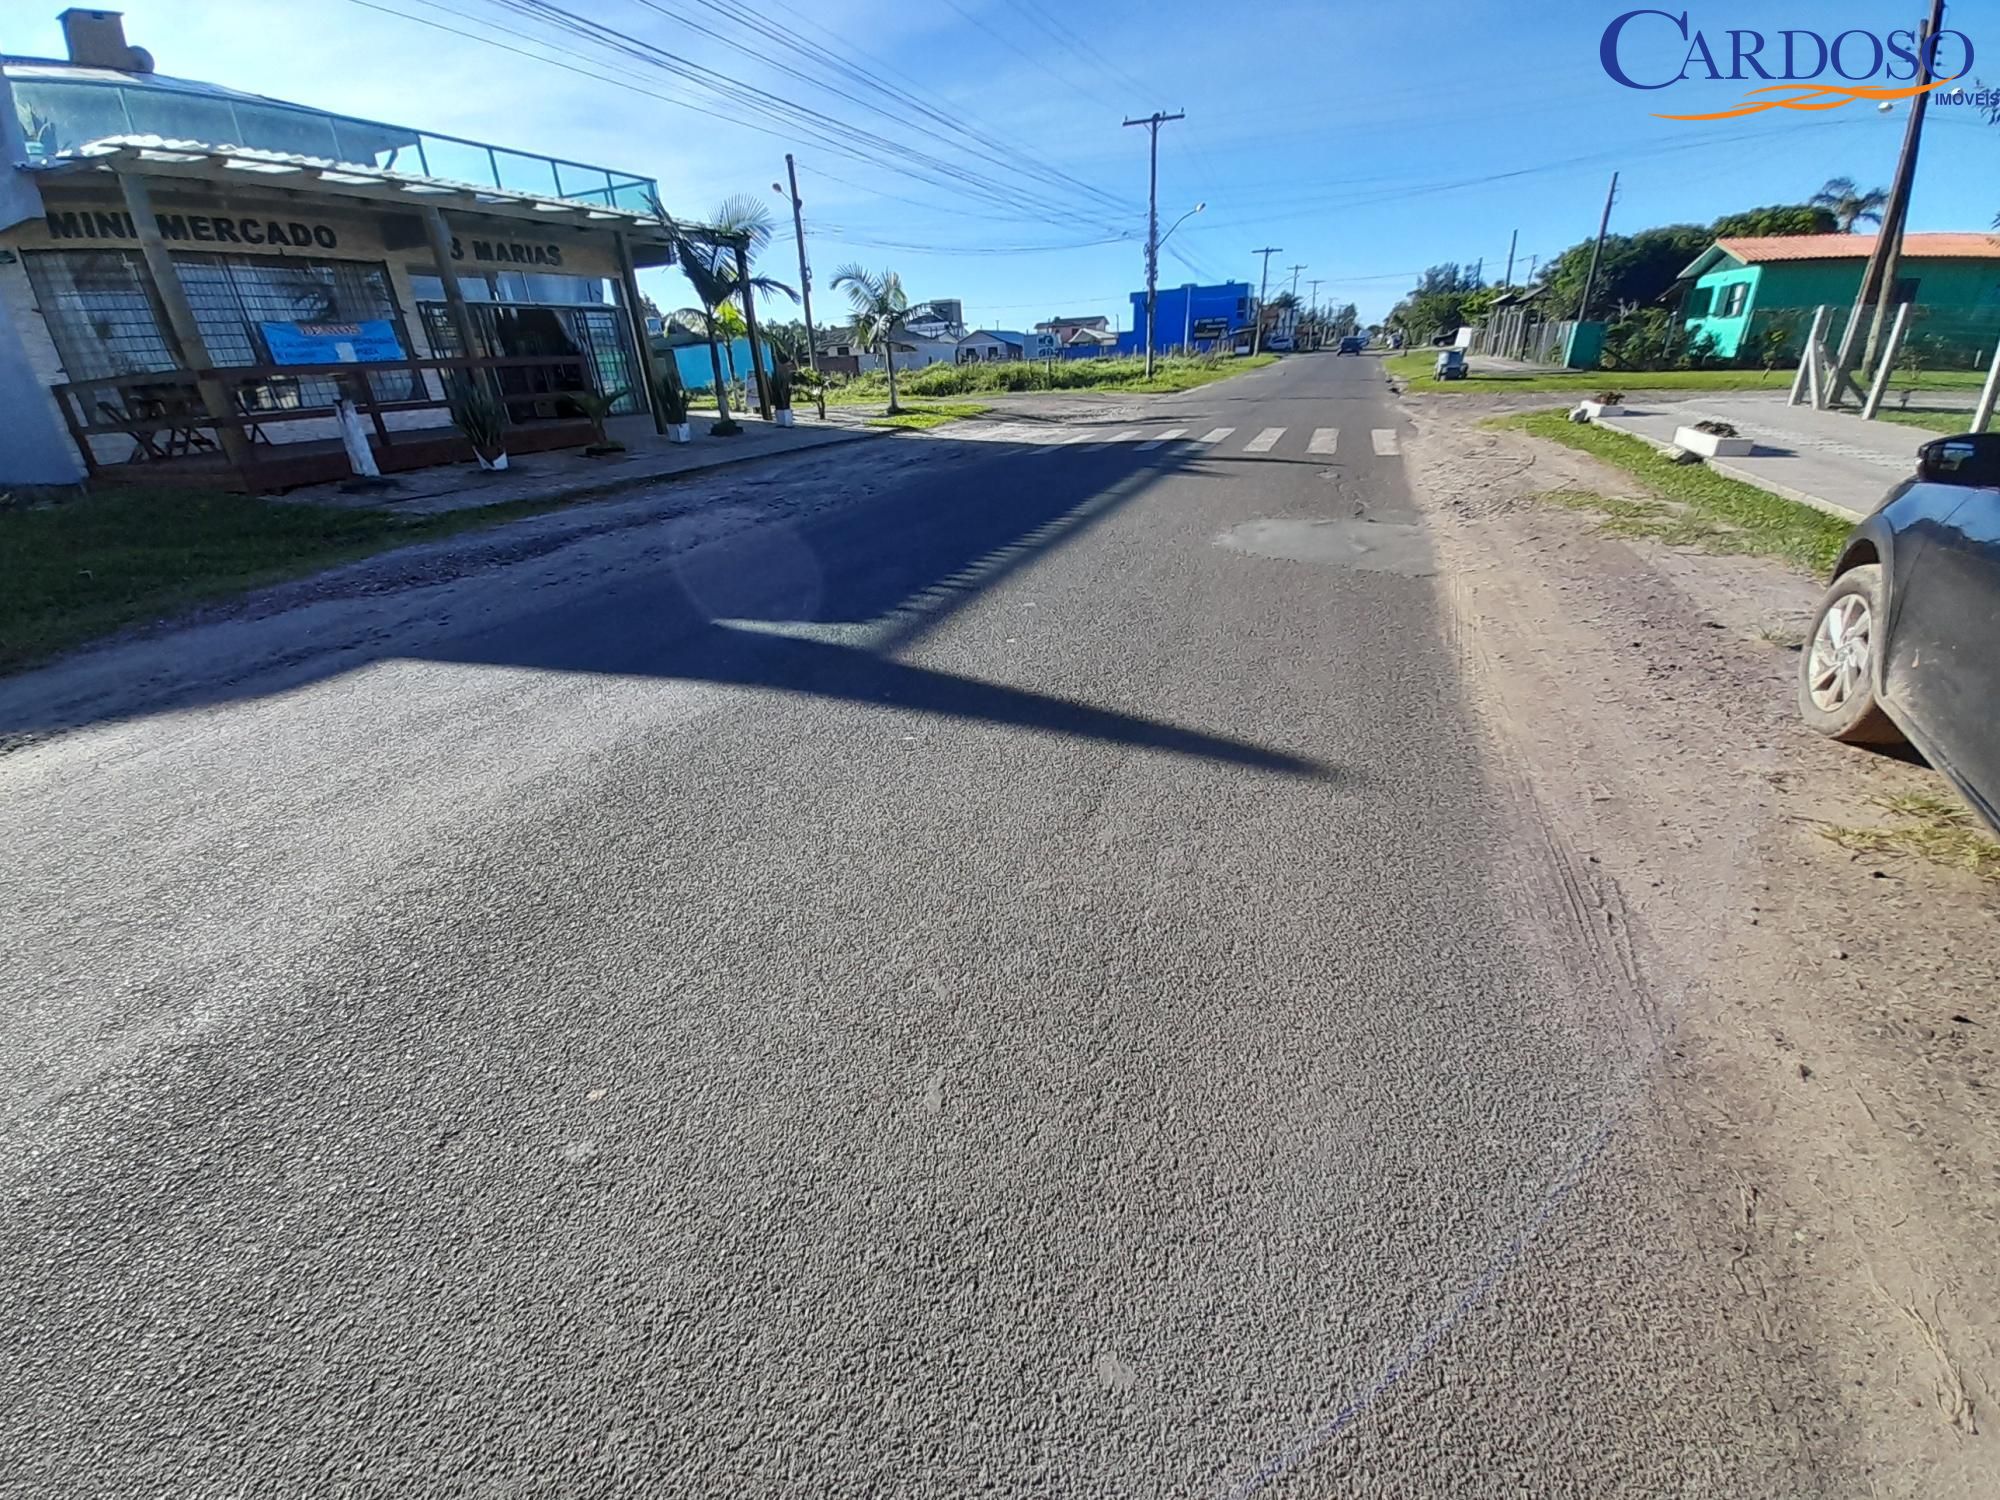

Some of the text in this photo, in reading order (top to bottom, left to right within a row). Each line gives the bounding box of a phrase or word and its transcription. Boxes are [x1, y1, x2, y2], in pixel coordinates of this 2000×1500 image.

[46, 211, 338, 249] MINI MERCADO
[449, 236, 562, 267] 3 MARIAS
